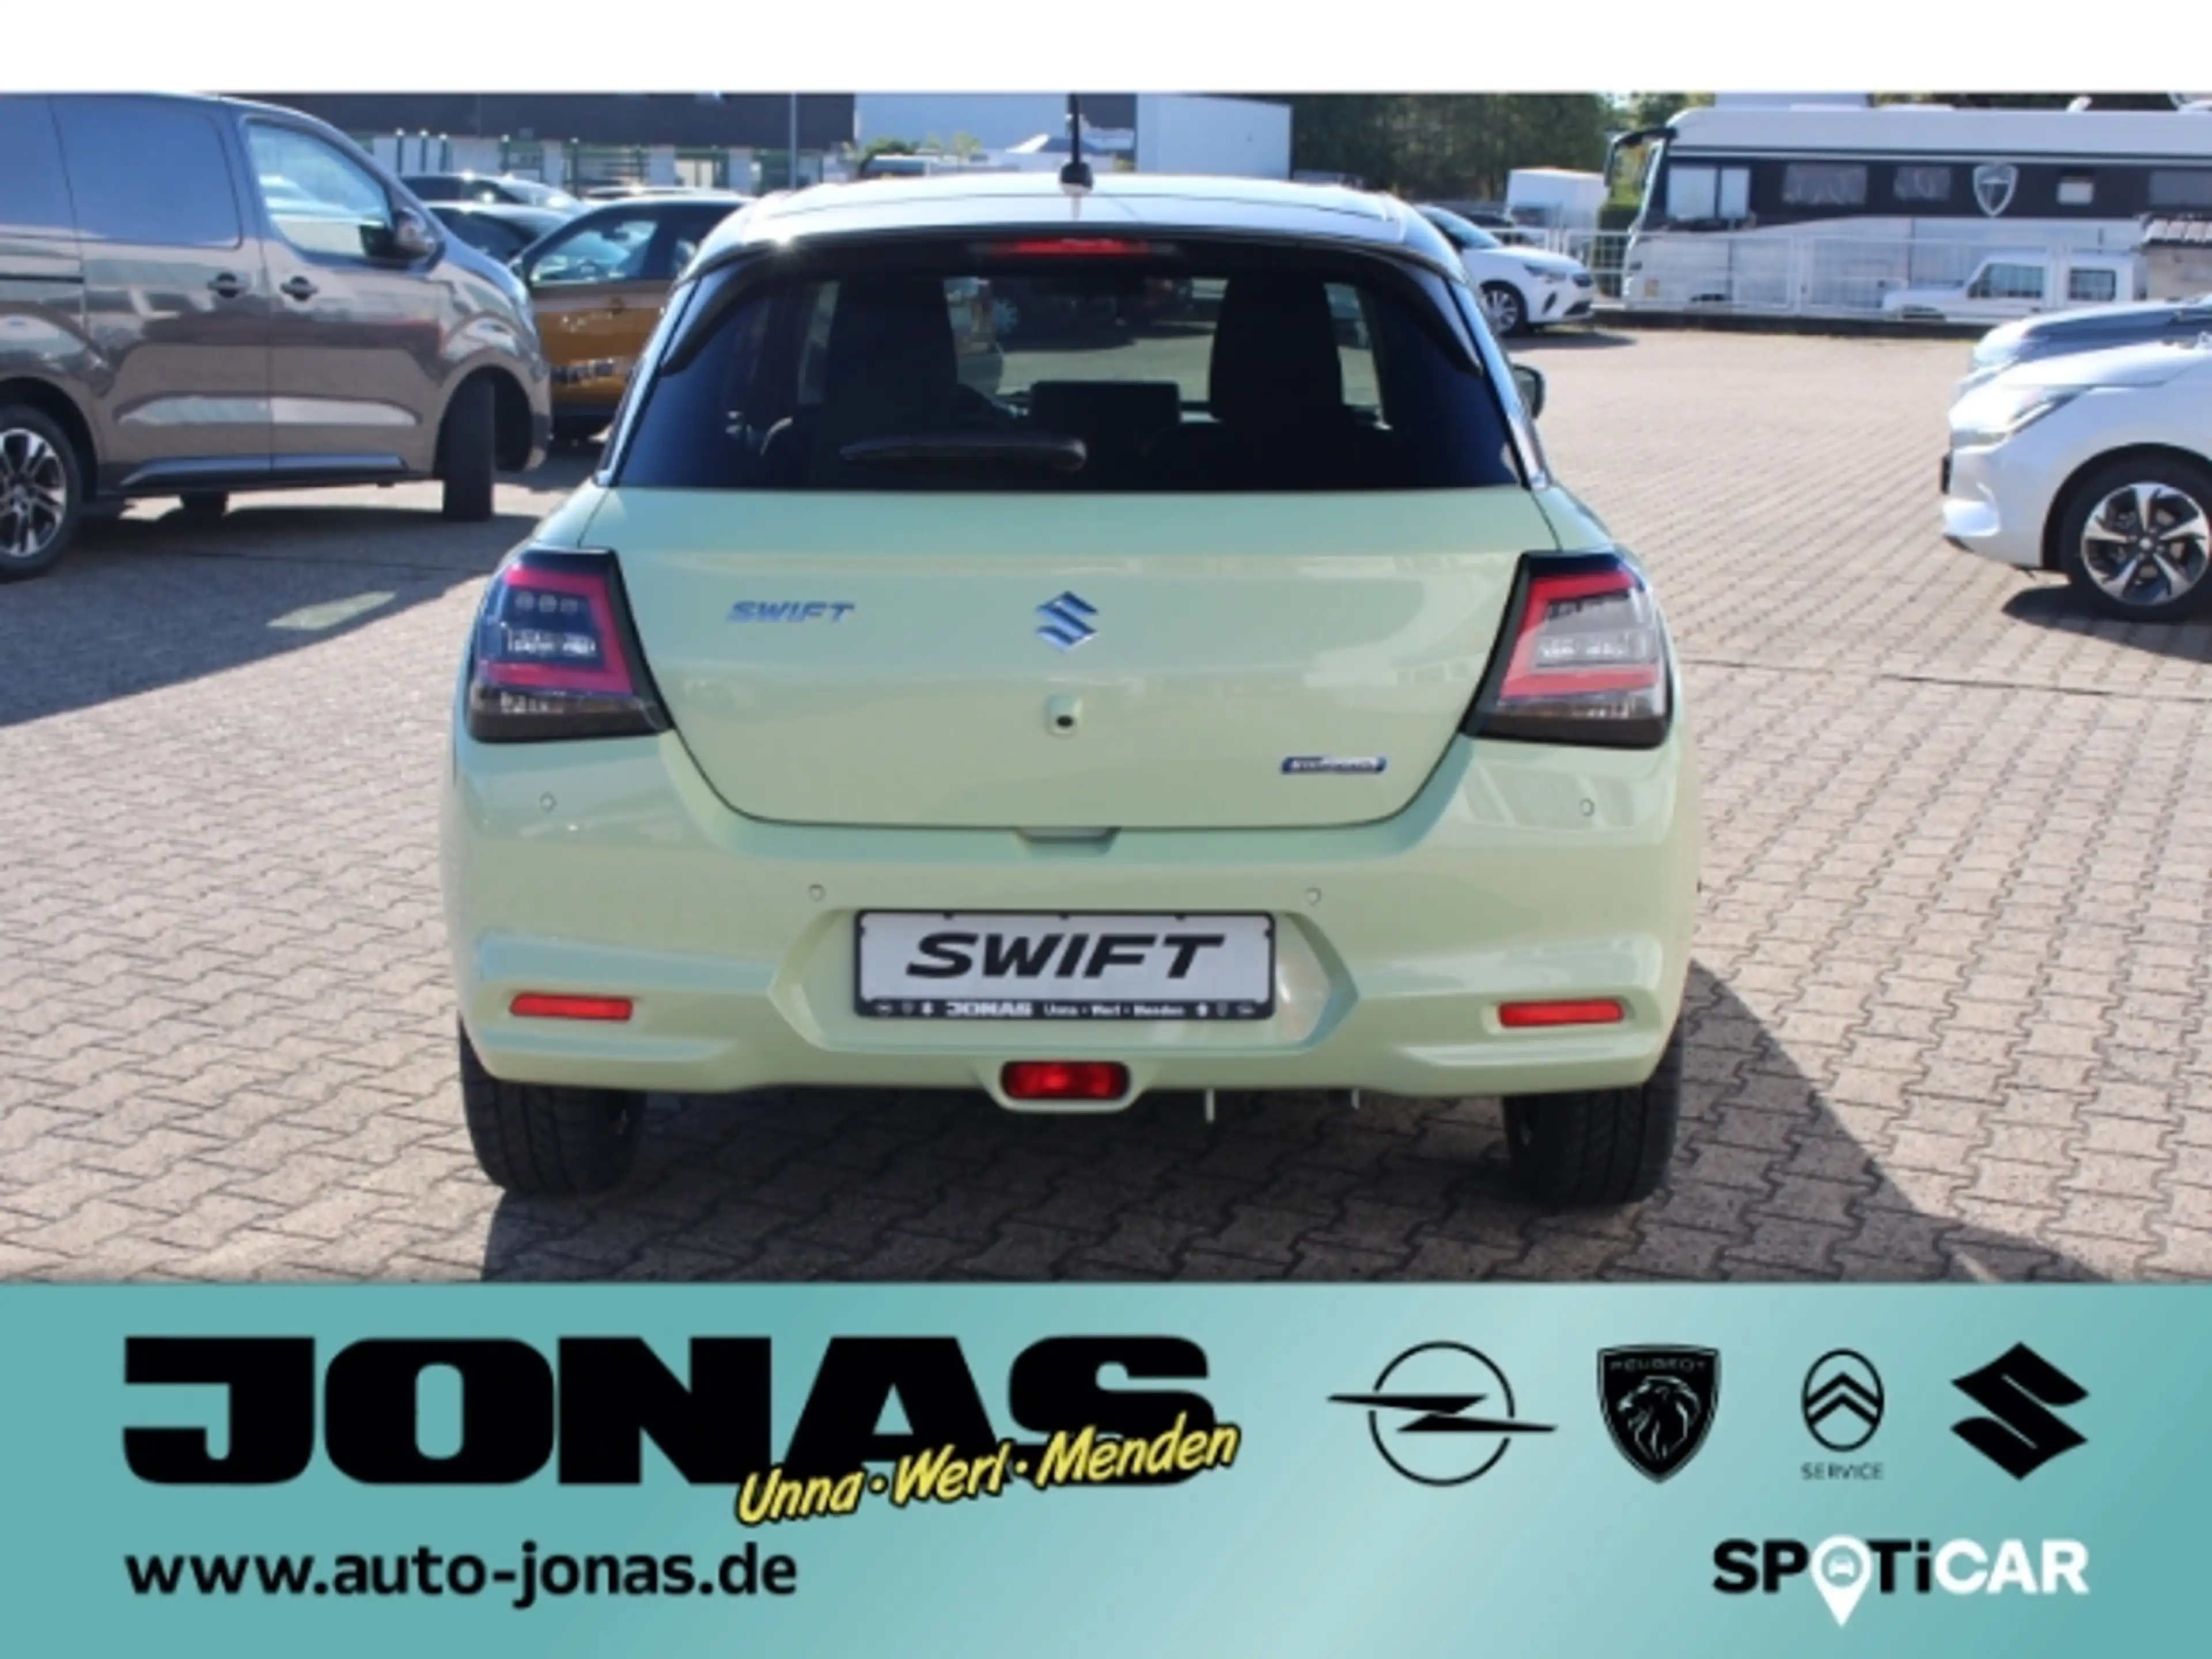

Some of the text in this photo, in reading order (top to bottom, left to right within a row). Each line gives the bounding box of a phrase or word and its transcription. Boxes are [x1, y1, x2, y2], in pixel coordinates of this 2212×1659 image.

[725, 600, 855, 623] SWIFT
[906, 932, 1225, 979] SWIFT
[945, 1001, 1033, 1018] JONAS
